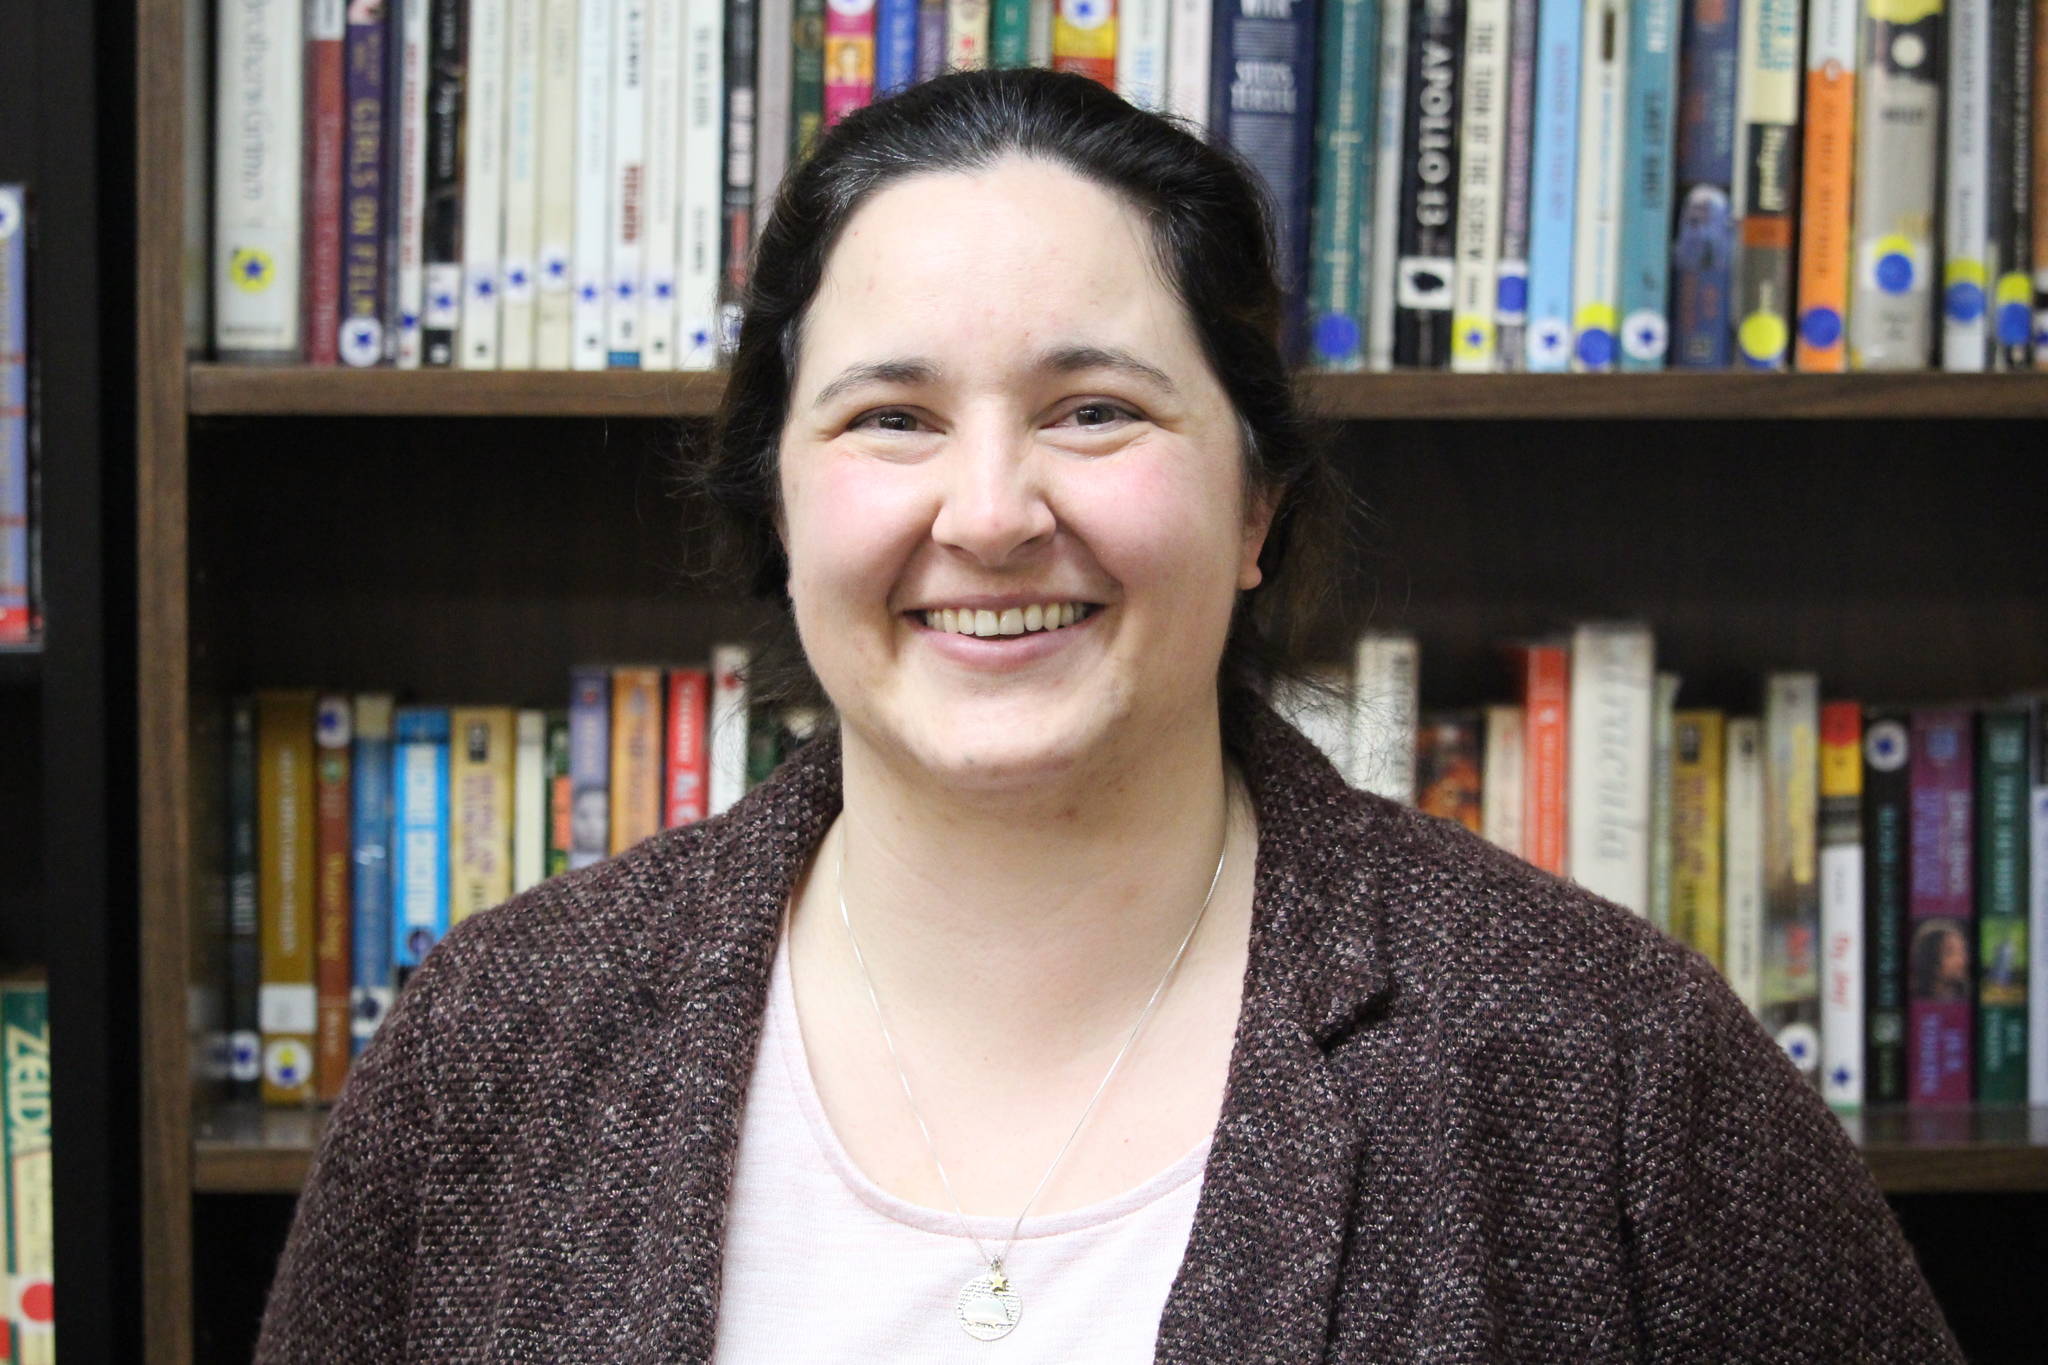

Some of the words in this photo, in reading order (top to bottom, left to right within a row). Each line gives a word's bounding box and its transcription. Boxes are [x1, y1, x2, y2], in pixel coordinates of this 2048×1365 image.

[1475, 23, 1494, 54] THE
[1417, 39, 1454, 184] APOLLO
[1473, 69, 1493, 116] TURN
[350, 97, 381, 190] GIRLS
[1470, 156, 1488, 187] THE
[350, 196, 379, 236] ON
[1415, 188, 1449, 227] 13
[347, 242, 378, 317] FILM
